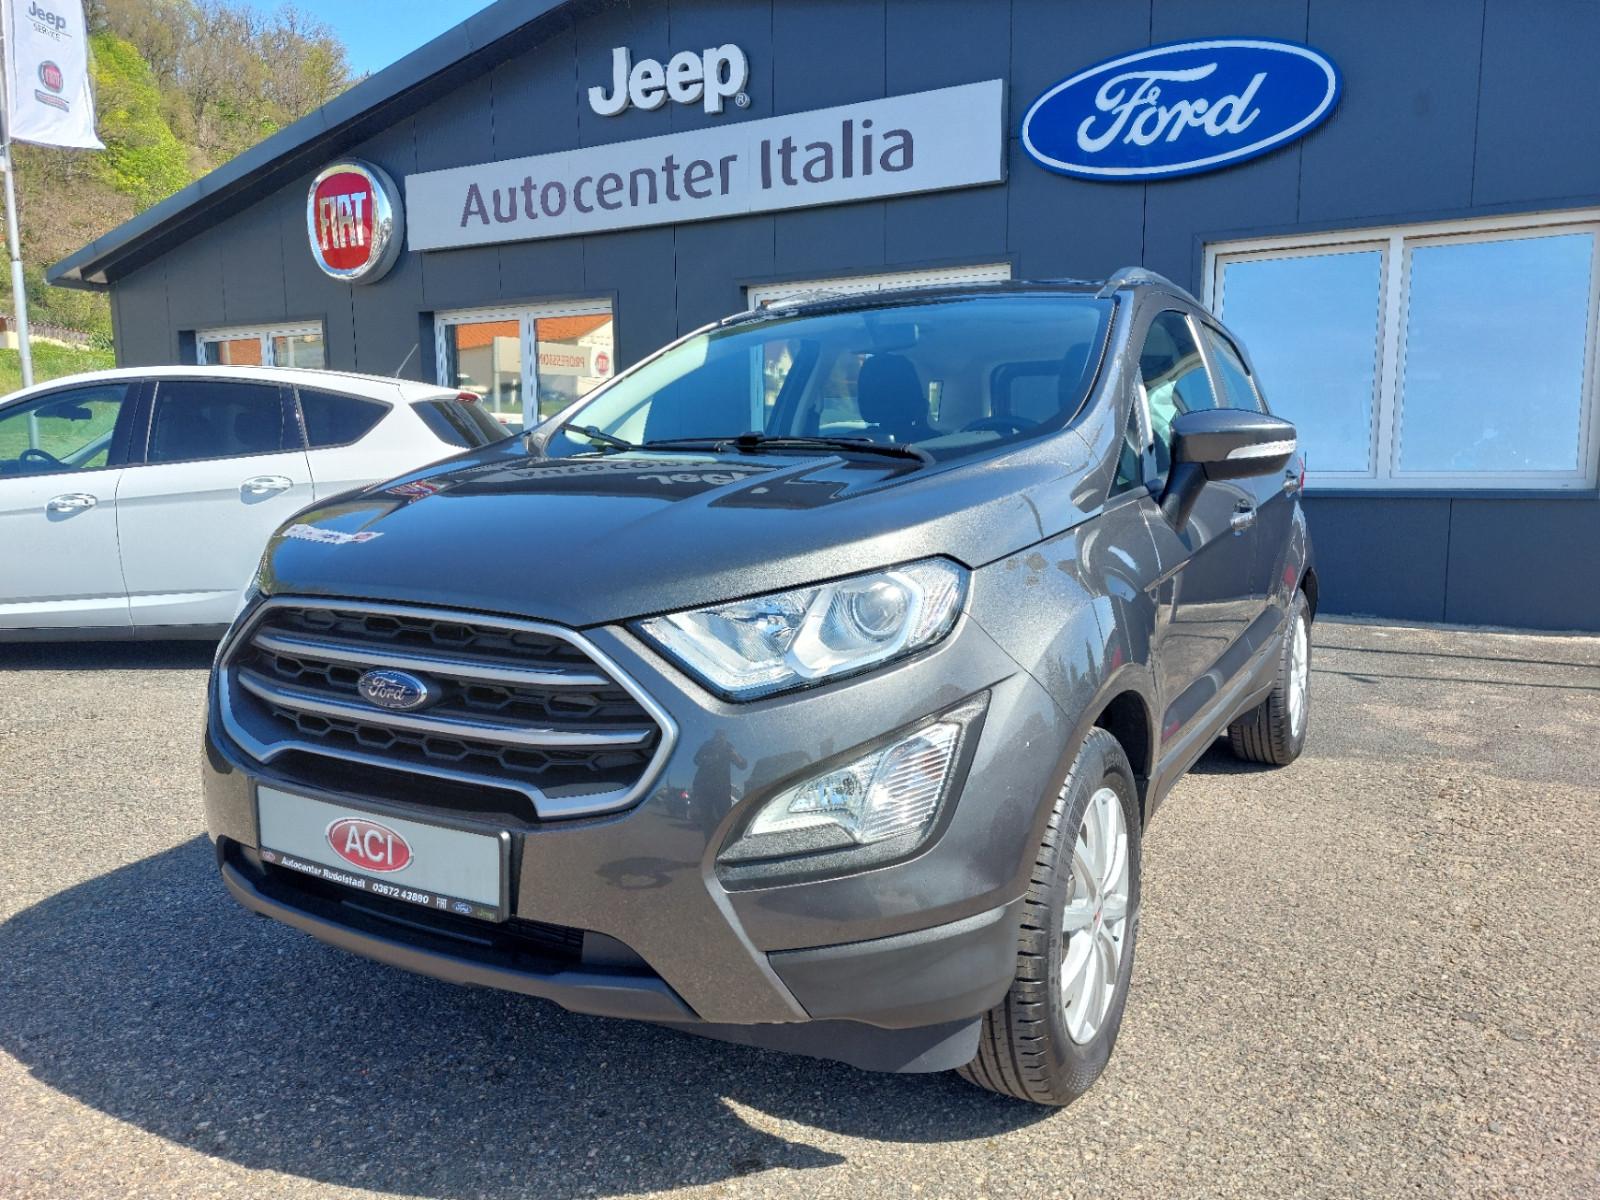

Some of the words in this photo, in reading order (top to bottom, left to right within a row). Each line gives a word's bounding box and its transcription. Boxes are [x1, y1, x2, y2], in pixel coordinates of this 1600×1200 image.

[28, 1, 66, 30] Jeep
[588, 43, 748, 116] Jeep
[1076, 62, 1268, 153] Ford
[460, 154, 738, 228] Autocenter
[760, 119, 914, 190] Italia
[319, 191, 367, 251] FIAT
[368, 676, 406, 700] Ford
[345, 825, 393, 865] ACI
[281, 856, 321, 876] Autocenter
[323, 868, 366, 889] Rudolstadt
[372, 882, 400, 898] 03672
[436, 897, 448, 910] FIAT
